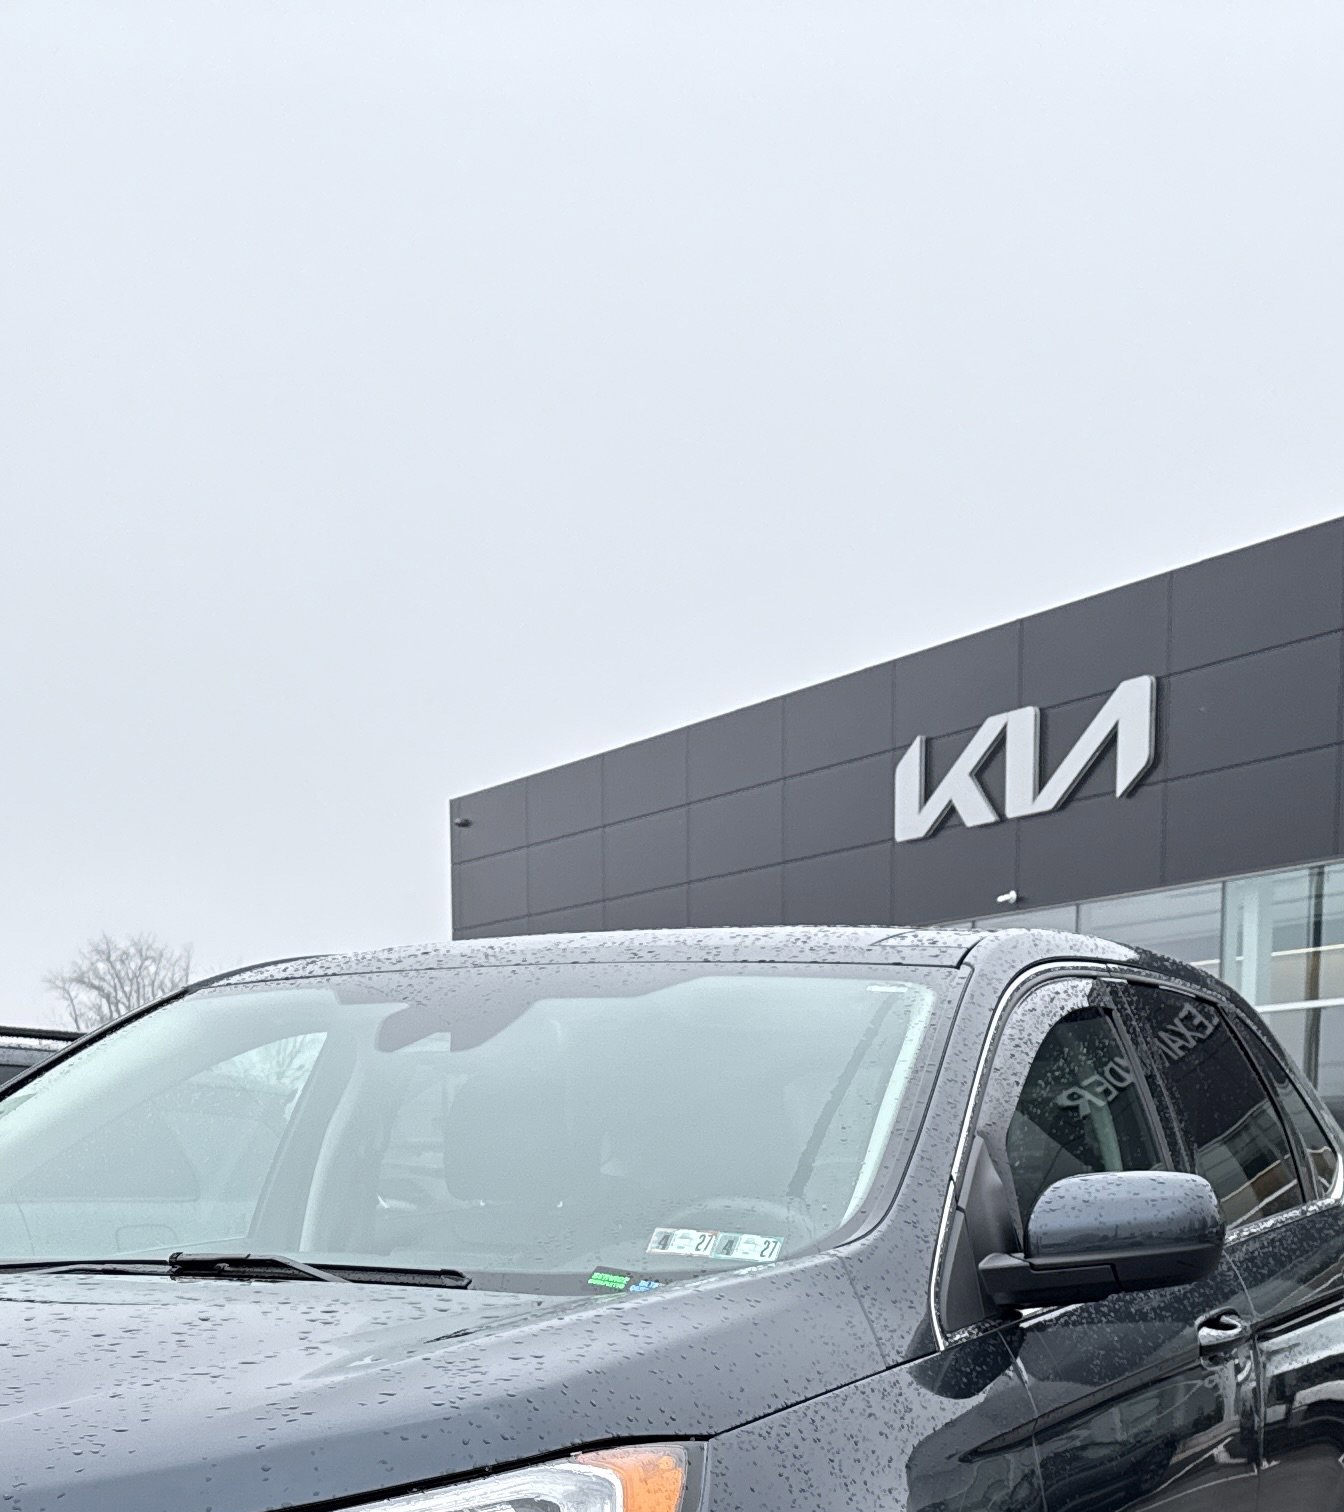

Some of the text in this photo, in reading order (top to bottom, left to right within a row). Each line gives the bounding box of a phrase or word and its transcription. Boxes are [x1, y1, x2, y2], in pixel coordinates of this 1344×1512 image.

[894, 674, 1156, 843] KIA
[657, 1233, 713, 1252] 4 27
[721, 1239, 778, 1259] 4 27
